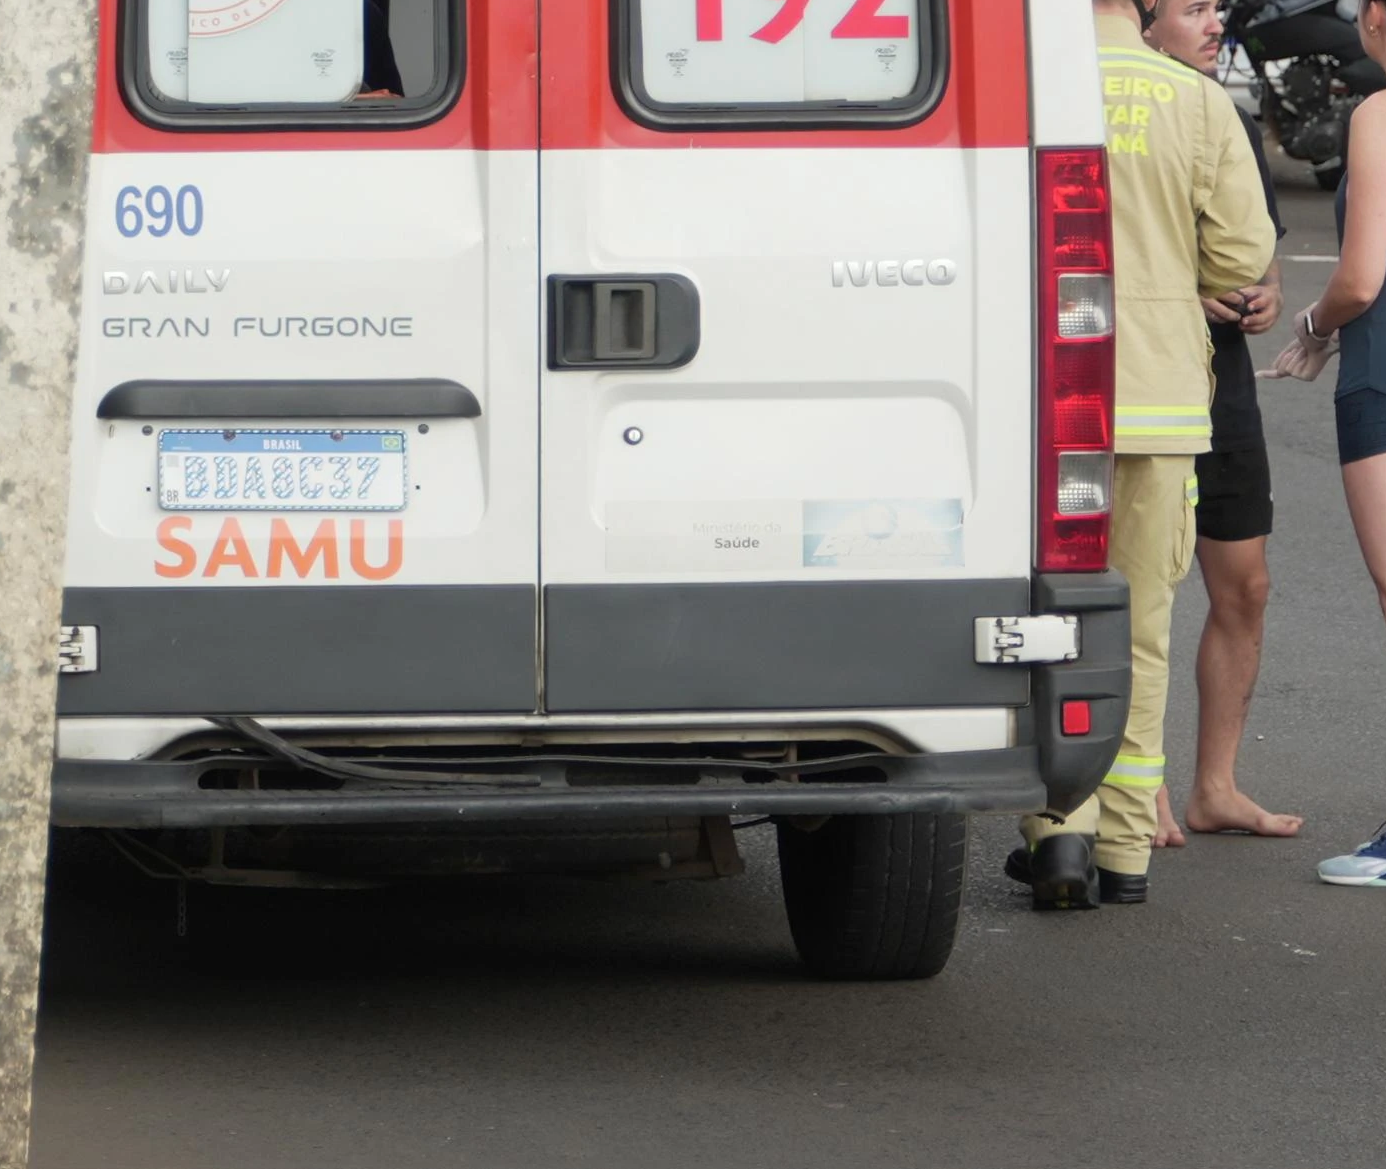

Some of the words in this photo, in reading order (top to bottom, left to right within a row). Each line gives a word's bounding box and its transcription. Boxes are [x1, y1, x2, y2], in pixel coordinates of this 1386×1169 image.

[1104, 76, 1175, 104] EIRO
[115, 184, 204, 238] 690
[102, 268, 231, 295] DAILY
[830, 260, 957, 288] IVECO
[102, 317, 209, 338] GRAN
[234, 316, 413, 337] FURGONE
[263, 439, 302, 451] BRASIL
[184, 456, 381, 499] BDA8C37
[166, 490, 179, 503] BR
[692, 521, 762, 535] Ministério
[764, 521, 782, 534] da
[154, 515, 403, 581] SAMU
[714, 535, 761, 549] Saúde
